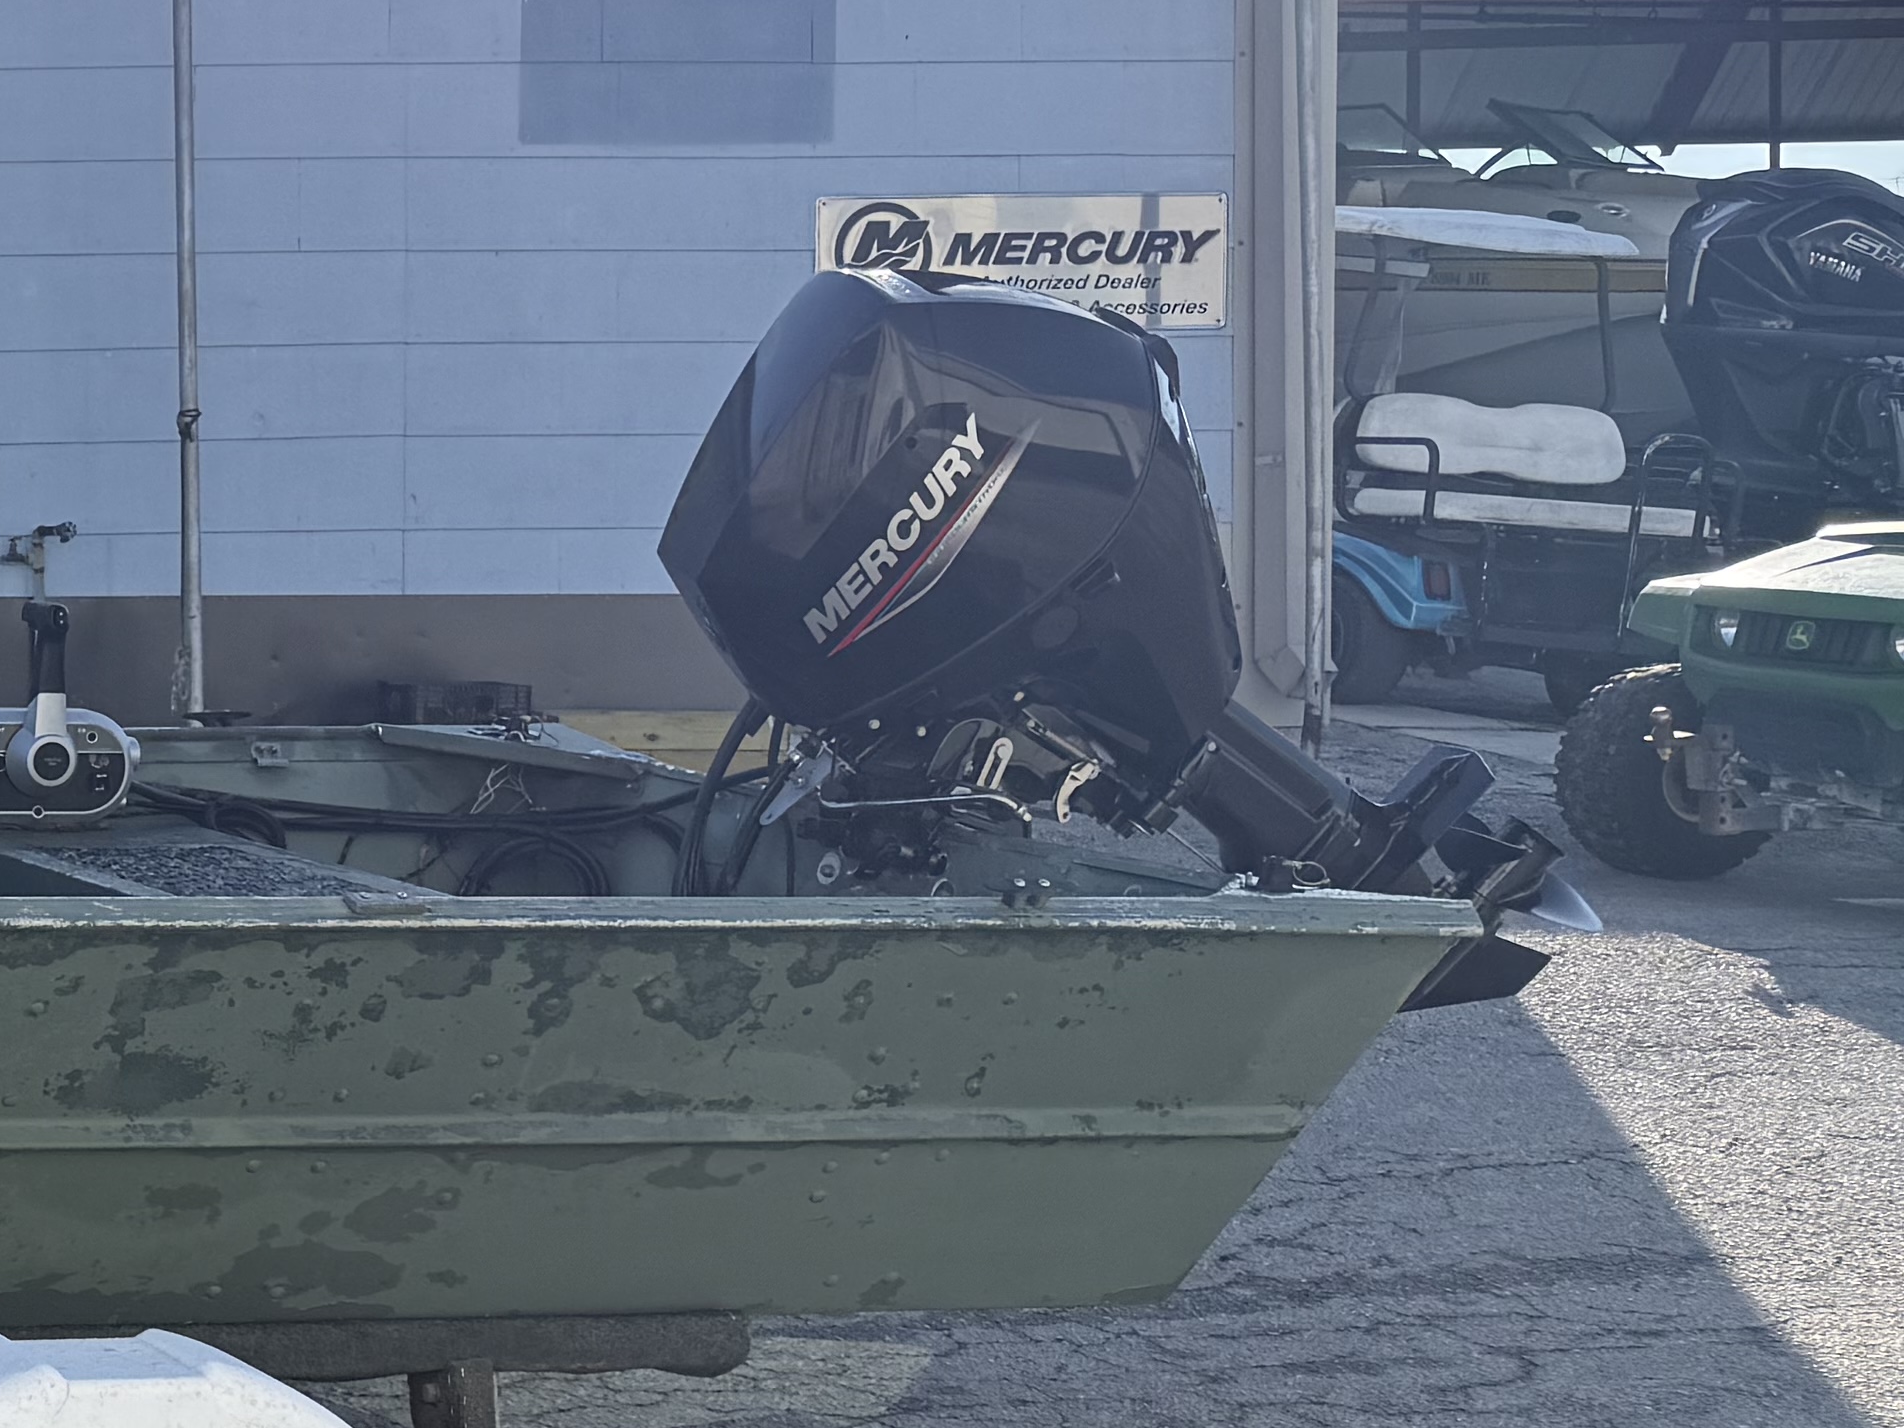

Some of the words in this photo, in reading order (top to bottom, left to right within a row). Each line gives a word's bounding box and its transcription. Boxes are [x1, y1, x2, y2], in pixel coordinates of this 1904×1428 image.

[941, 228, 1221, 267] MERCURY
[1094, 273, 1162, 290] Dealer
[802, 412, 986, 644] MERCURY
